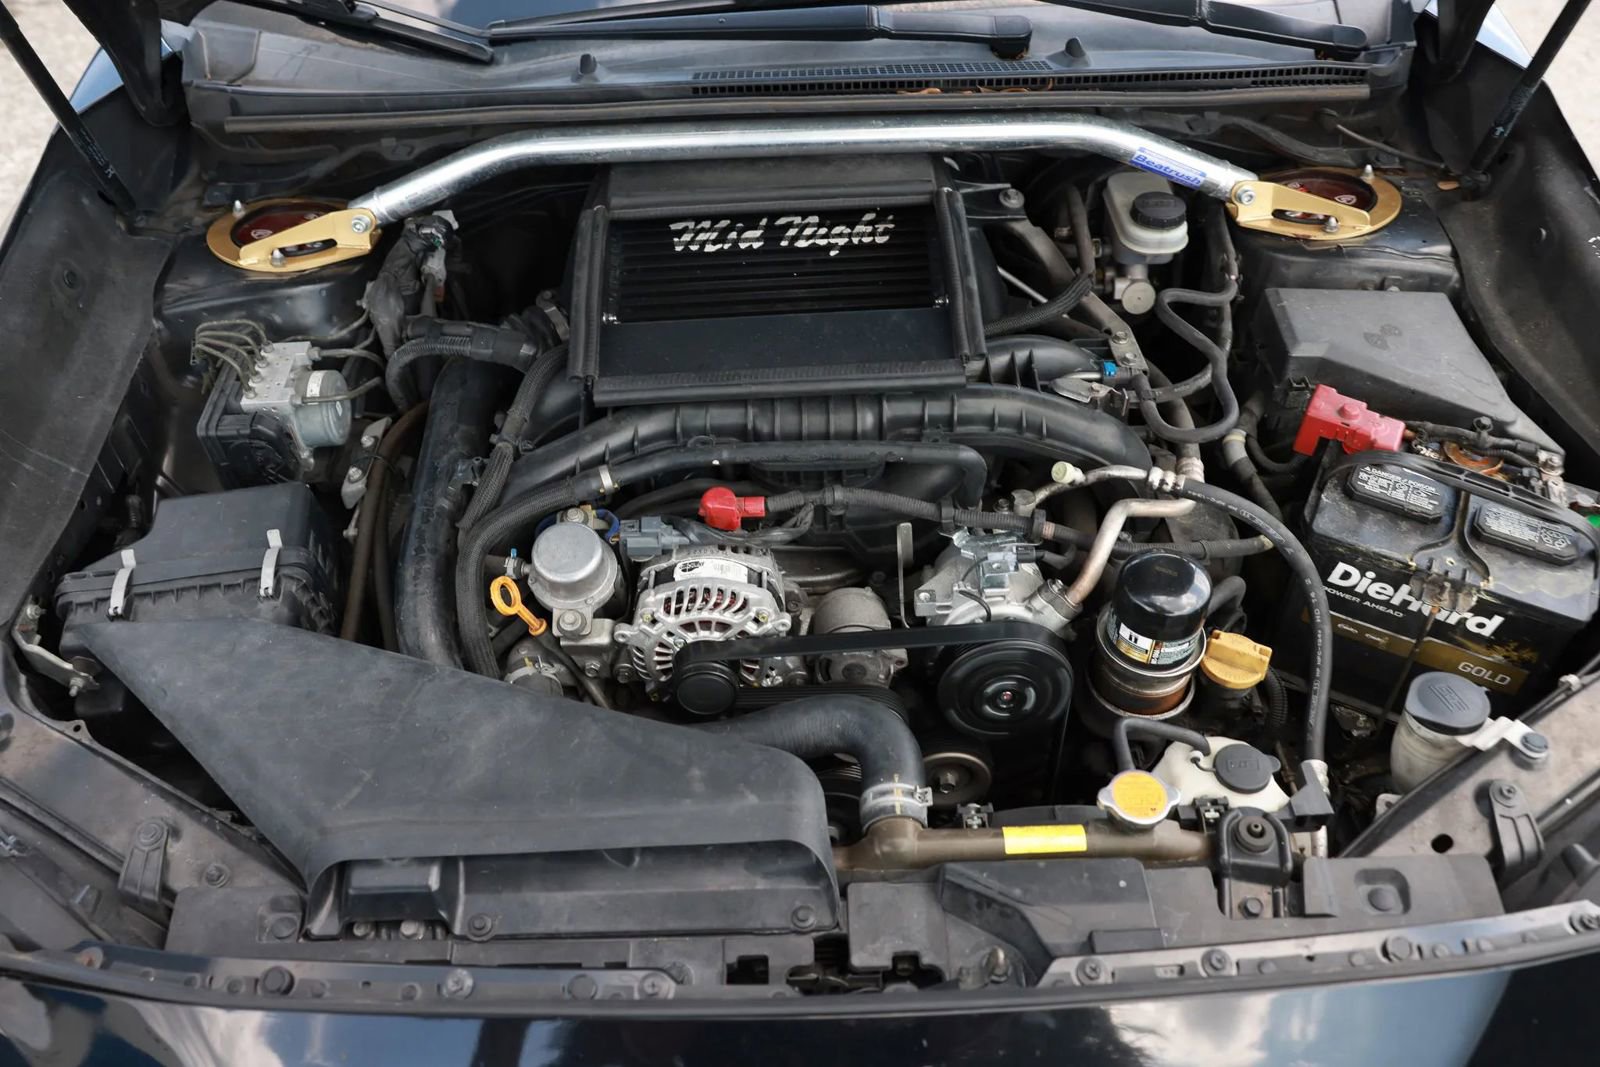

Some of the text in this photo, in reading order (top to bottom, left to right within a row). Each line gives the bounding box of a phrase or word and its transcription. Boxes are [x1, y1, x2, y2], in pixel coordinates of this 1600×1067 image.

[1134, 154, 1201, 185] Beatrush
[669, 212, 896, 257] Mid Night
[1362, 600, 1404, 618] AHEAD
[1457, 661, 1511, 686] GOLD
